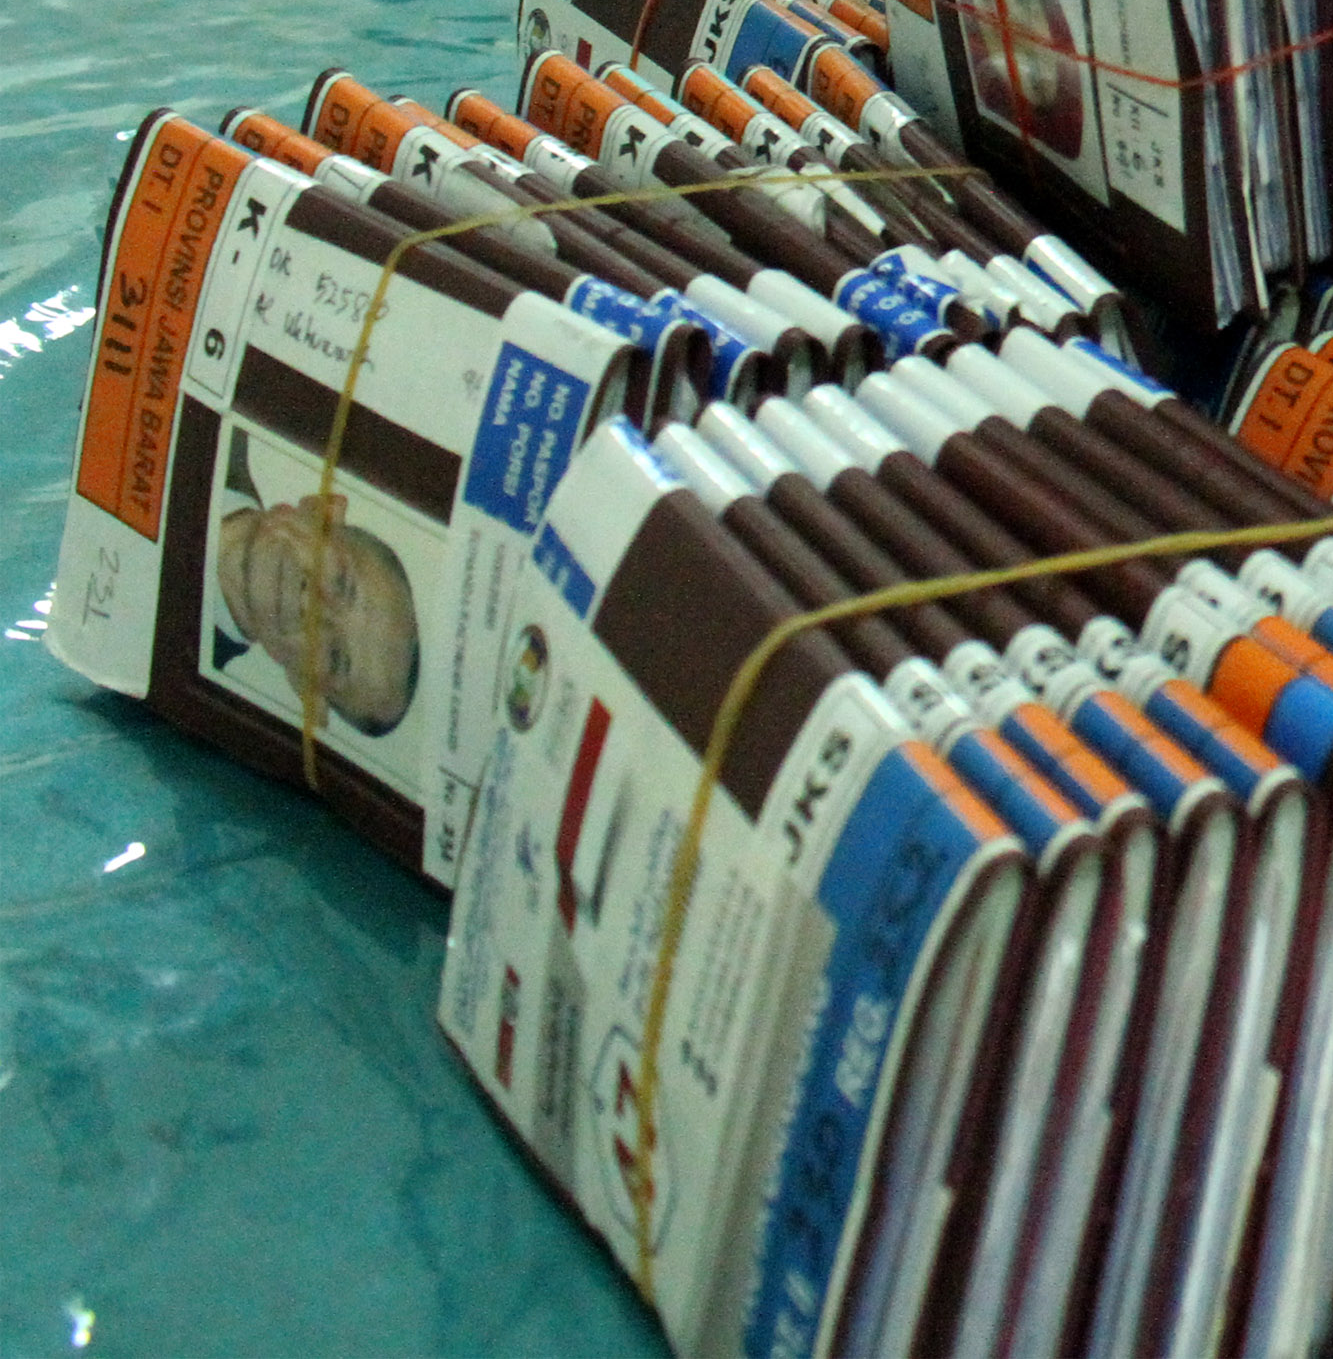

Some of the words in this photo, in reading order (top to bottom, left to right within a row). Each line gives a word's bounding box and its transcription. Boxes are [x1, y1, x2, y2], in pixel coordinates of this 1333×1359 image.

[164, 165, 225, 314] PROVINSI
[143, 314, 178, 402] JAWA
[203, 328, 226, 361] 6
[493, 357, 523, 426] NAMA
[131, 407, 163, 514] BARAT
[784, 727, 854, 865] JKS
